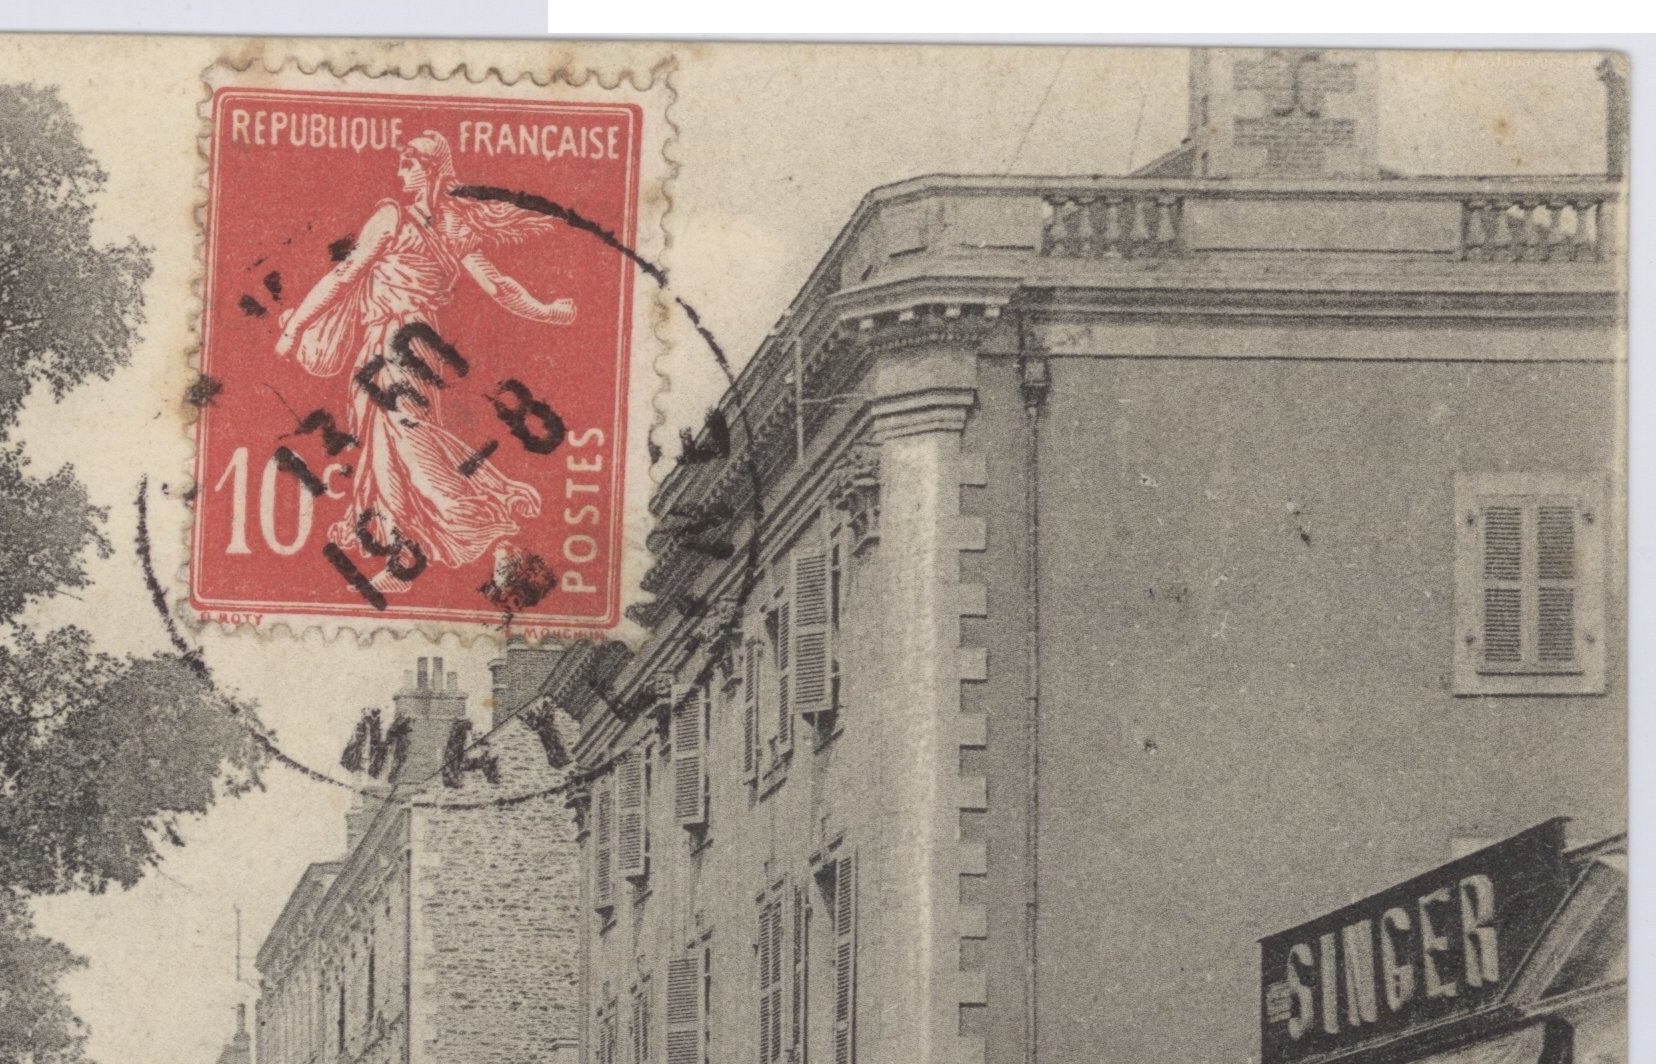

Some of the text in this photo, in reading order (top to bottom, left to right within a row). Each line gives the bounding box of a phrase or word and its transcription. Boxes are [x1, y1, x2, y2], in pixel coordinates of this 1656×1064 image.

[231, 108, 622, 161] REPUBLIQUE FRANÇAISE
[560, 426, 605, 594] POSTES
[1282, 873, 1500, 1041] SINGER
